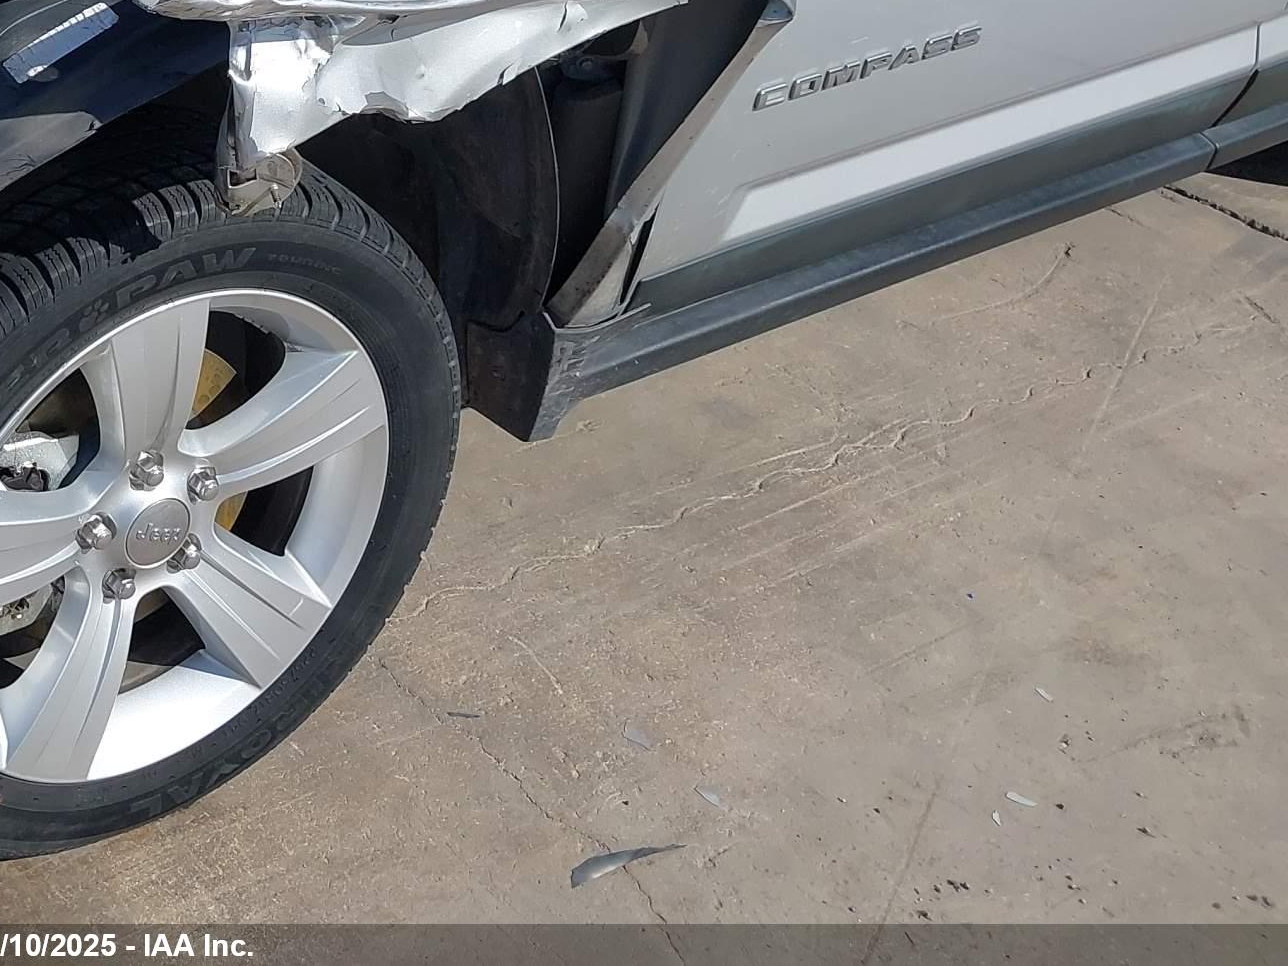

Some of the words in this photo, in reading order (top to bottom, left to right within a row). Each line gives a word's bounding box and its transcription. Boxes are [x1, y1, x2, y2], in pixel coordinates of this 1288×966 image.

[752, 25, 983, 112] COMPASS
[115, 246, 256, 310] PAW
[135, 522, 182, 545] Jeep
